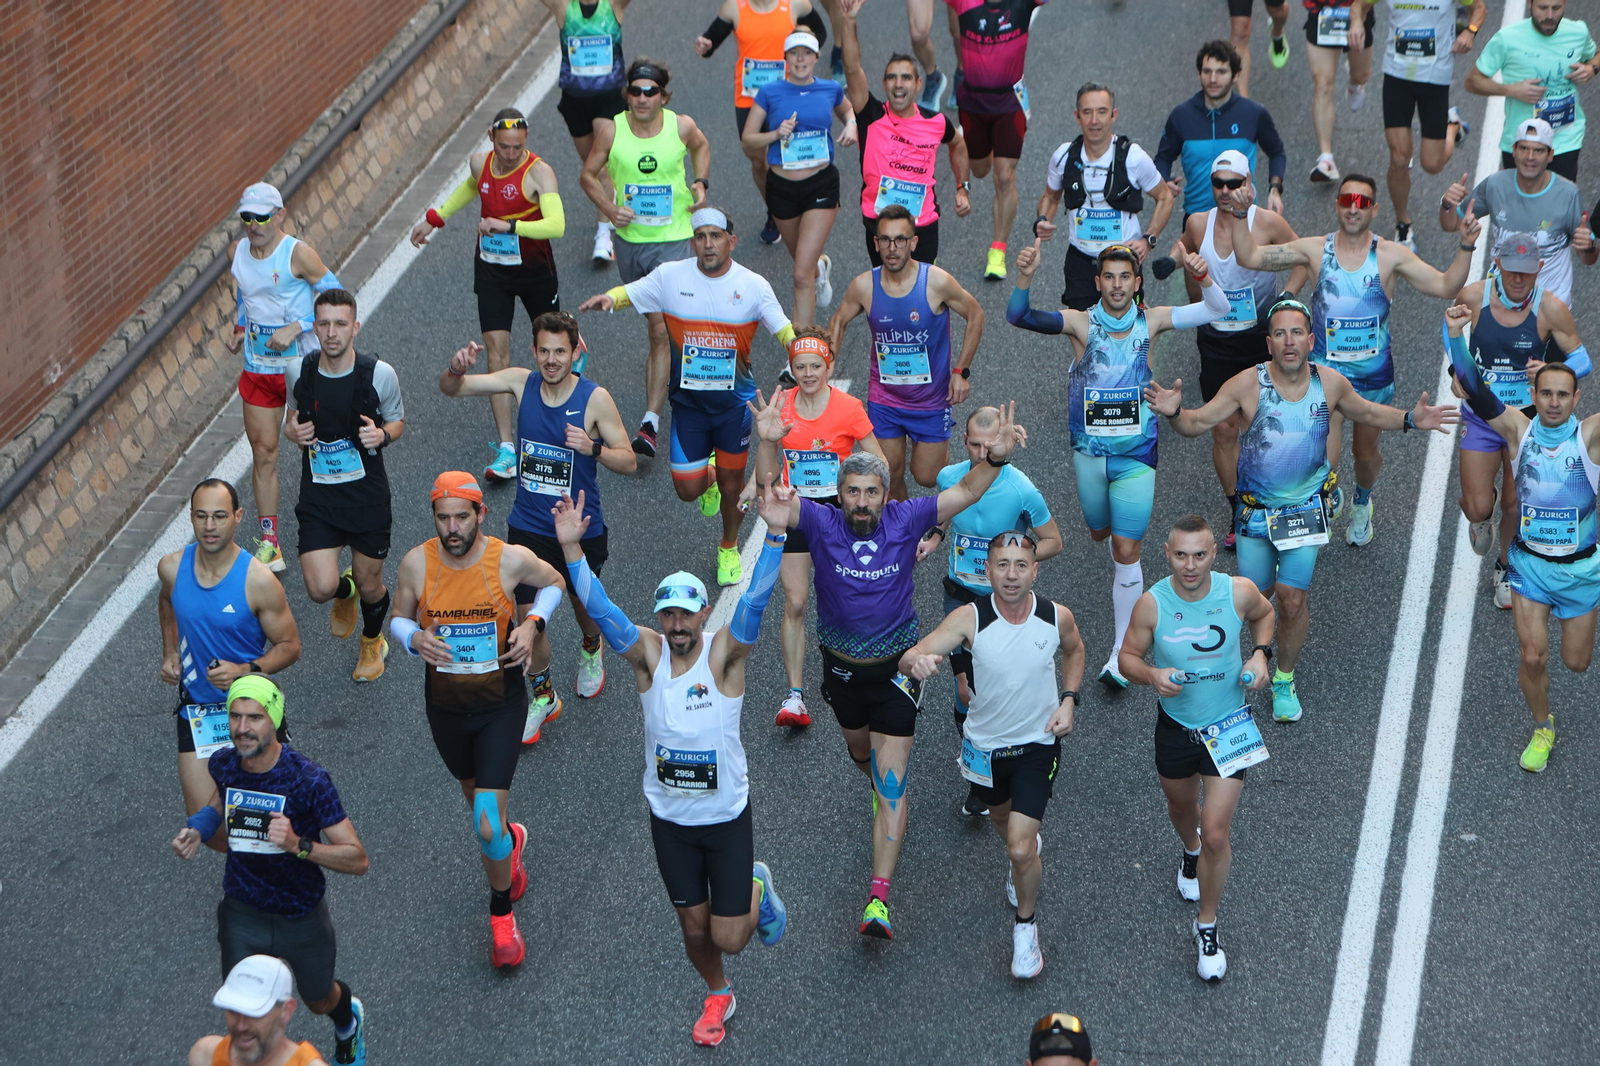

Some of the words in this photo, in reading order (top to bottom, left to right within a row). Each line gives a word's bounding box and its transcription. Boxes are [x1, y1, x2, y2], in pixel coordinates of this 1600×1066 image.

[1550, 98, 1572, 108] ZURICH
[797, 130, 820, 138] ZURICH
[896, 184, 922, 193] ZURICH
[684, 335, 736, 348] MARCHENA
[876, 328, 930, 344] FILÍPIDES
[794, 339, 818, 350] OTSO
[1500, 374, 1528, 382] ZURICH
[1103, 392, 1132, 400] ZURICH
[322, 442, 350, 454] ZURICH
[537, 446, 567, 460] ZURICH
[802, 452, 832, 460] ZURICH
[534, 463, 553, 474] 3175
[544, 474, 568, 486] GALAXY
[1538, 510, 1570, 519] ZURICH
[1287, 518, 1305, 527] 3271
[1539, 526, 1558, 536] 6383
[1528, 534, 1554, 545] CONMIGO
[974, 558, 986, 566] 437
[836, 562, 900, 580] sportguru
[426, 608, 498, 619] SAMBURIEL
[454, 626, 488, 636] ZURICH
[1221, 710, 1250, 730] ZURICH
[1229, 732, 1250, 747] 6022
[674, 752, 710, 763] ZURICH
[995, 748, 1024, 758] naked
[674, 770, 696, 778] 2958
[664, 778, 676, 787] MR
[676, 780, 708, 789] SARRION
[246, 796, 276, 809] ZURICH
[230, 828, 254, 840] ANTONIO
